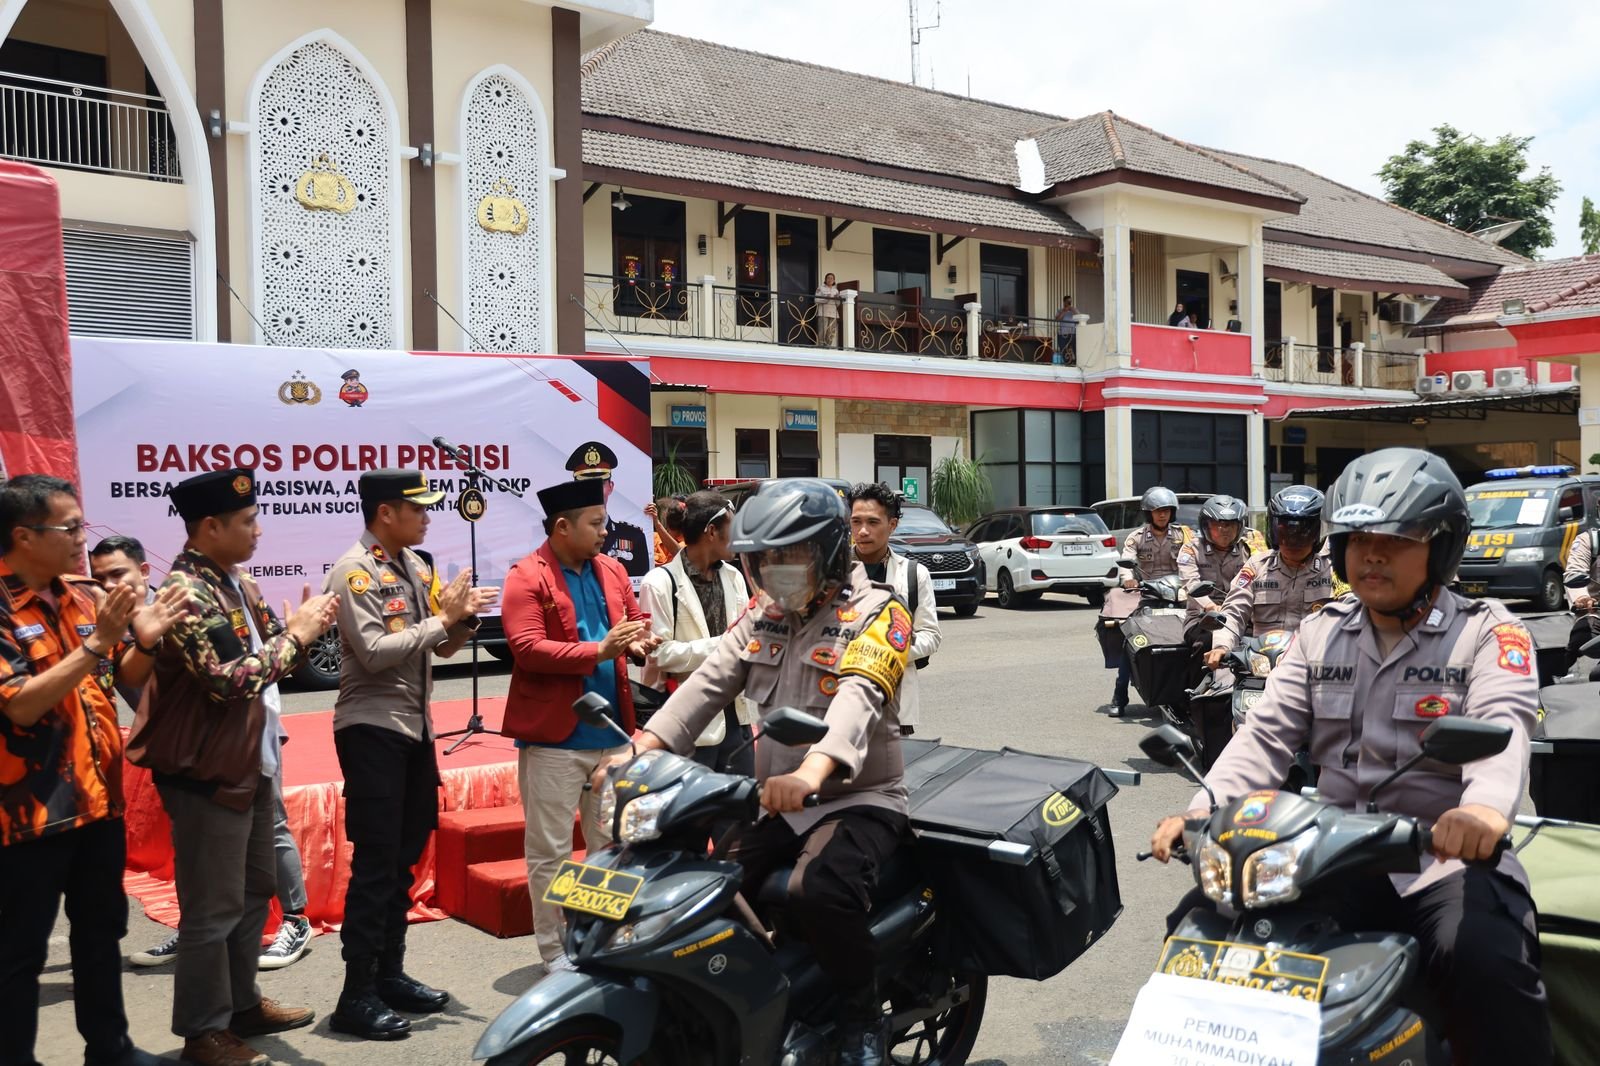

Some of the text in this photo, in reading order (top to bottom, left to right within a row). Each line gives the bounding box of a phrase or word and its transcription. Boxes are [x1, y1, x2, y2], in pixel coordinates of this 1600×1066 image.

[794, 413, 817, 426] PAMINAL
[136, 443, 510, 473] BAKSOS POLRI PRESISI
[497, 477, 531, 493] OKP
[272, 502, 322, 516] BULAN
[325, 501, 360, 515] SUCI
[1336, 508, 1377, 519] INK
[1306, 577, 1331, 588] POLRI
[821, 626, 857, 641] POLRI
[1402, 665, 1466, 684] POLRI
[1183, 1016, 1260, 1045] PEMUDA
[1143, 1028, 1294, 1066] MUHAMMADIYAH
